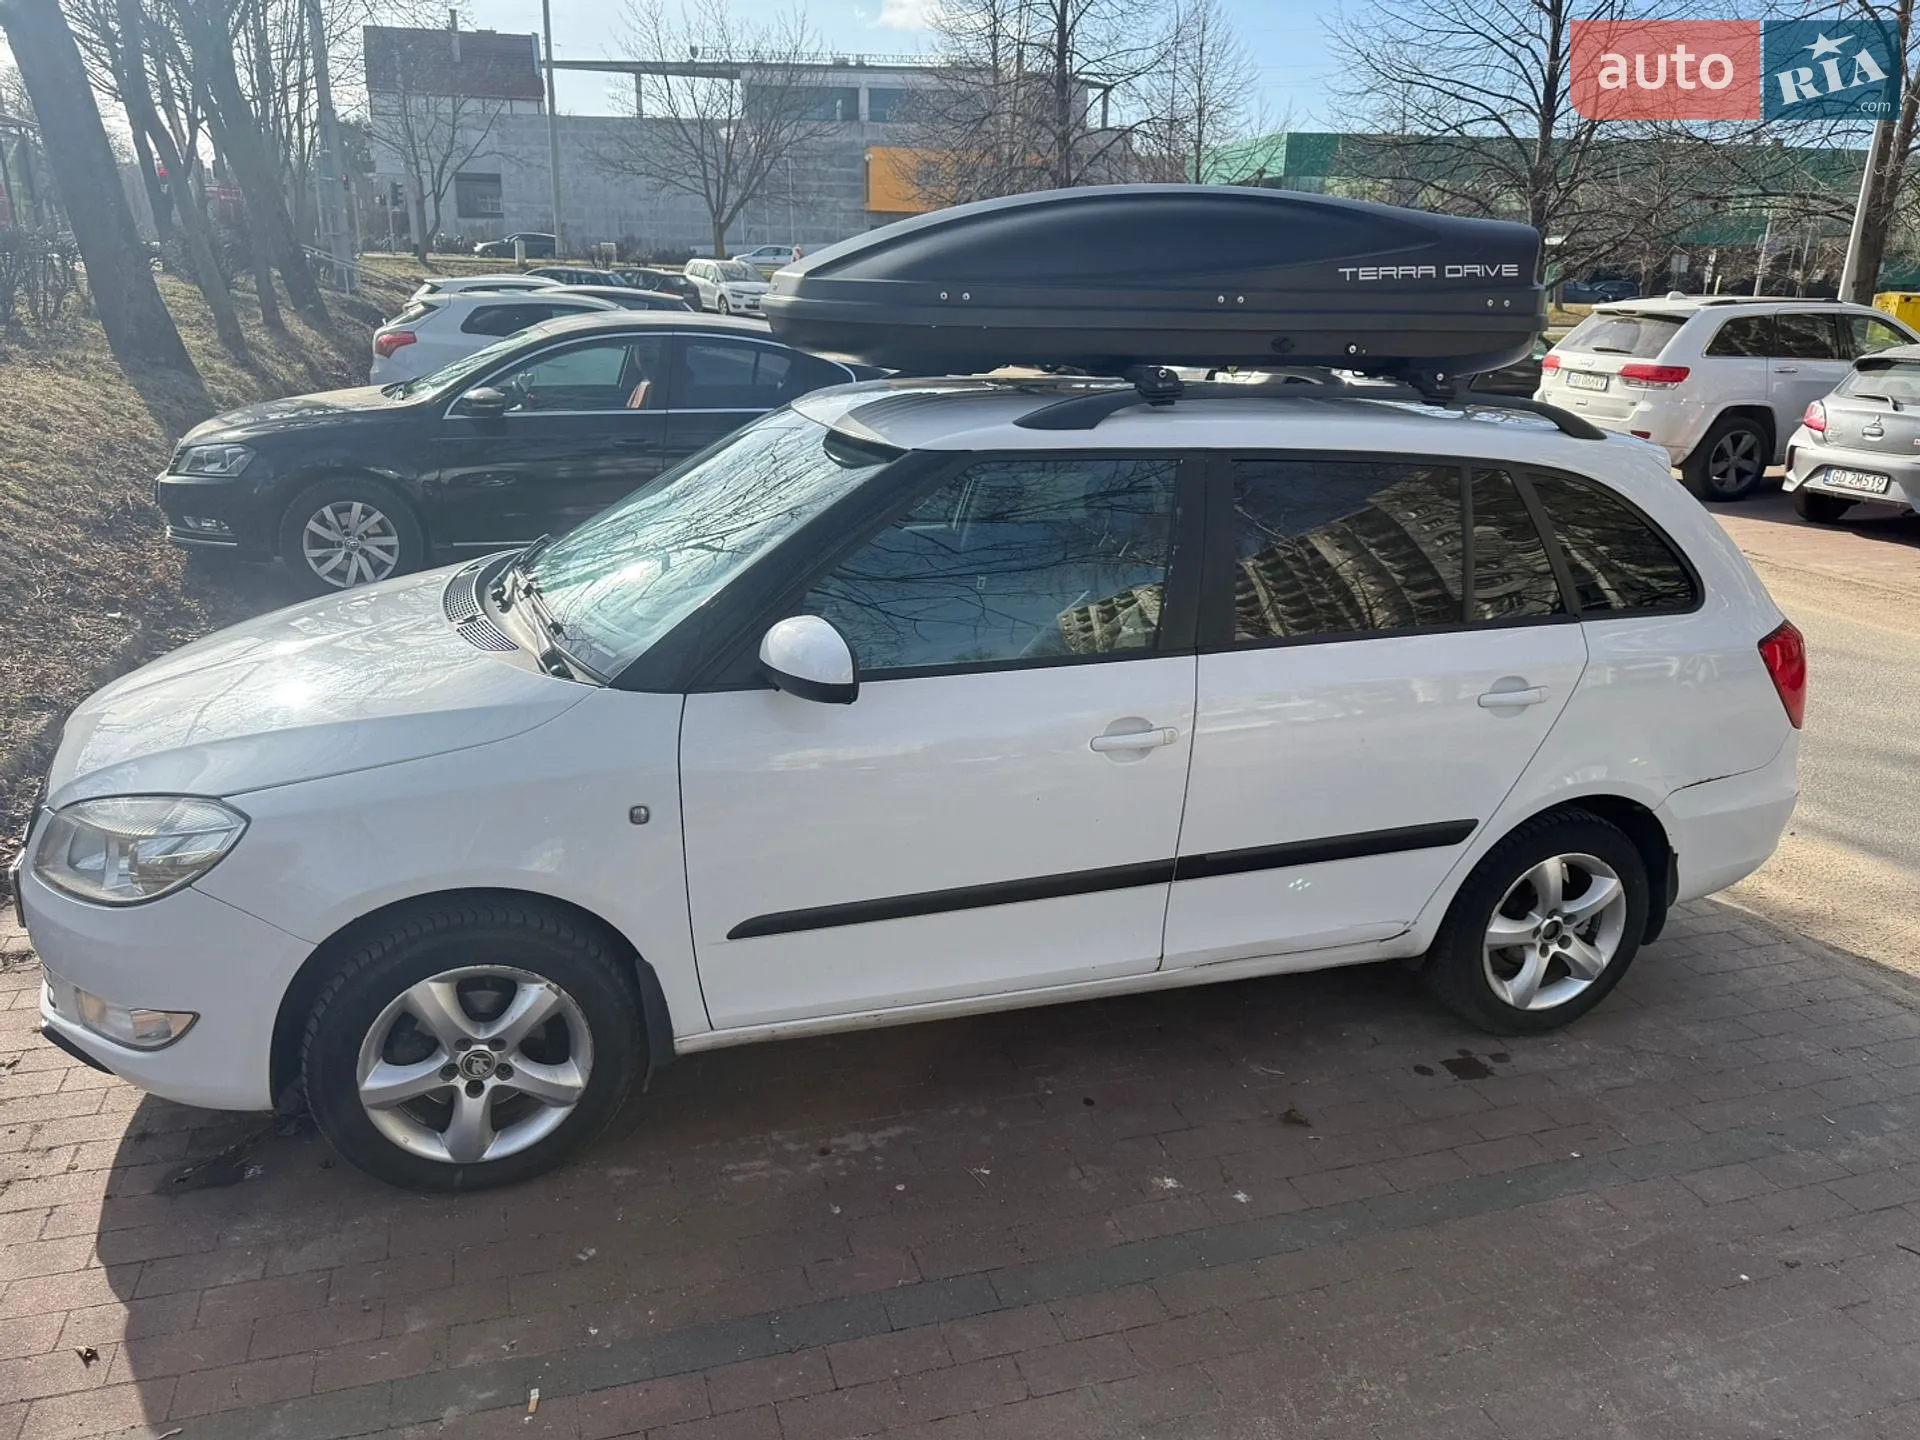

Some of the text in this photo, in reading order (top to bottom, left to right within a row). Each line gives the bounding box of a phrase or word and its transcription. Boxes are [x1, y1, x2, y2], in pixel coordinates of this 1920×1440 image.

[1338, 264, 1519, 281] TERRA DRIVE
[1832, 470, 1847, 483] GD
